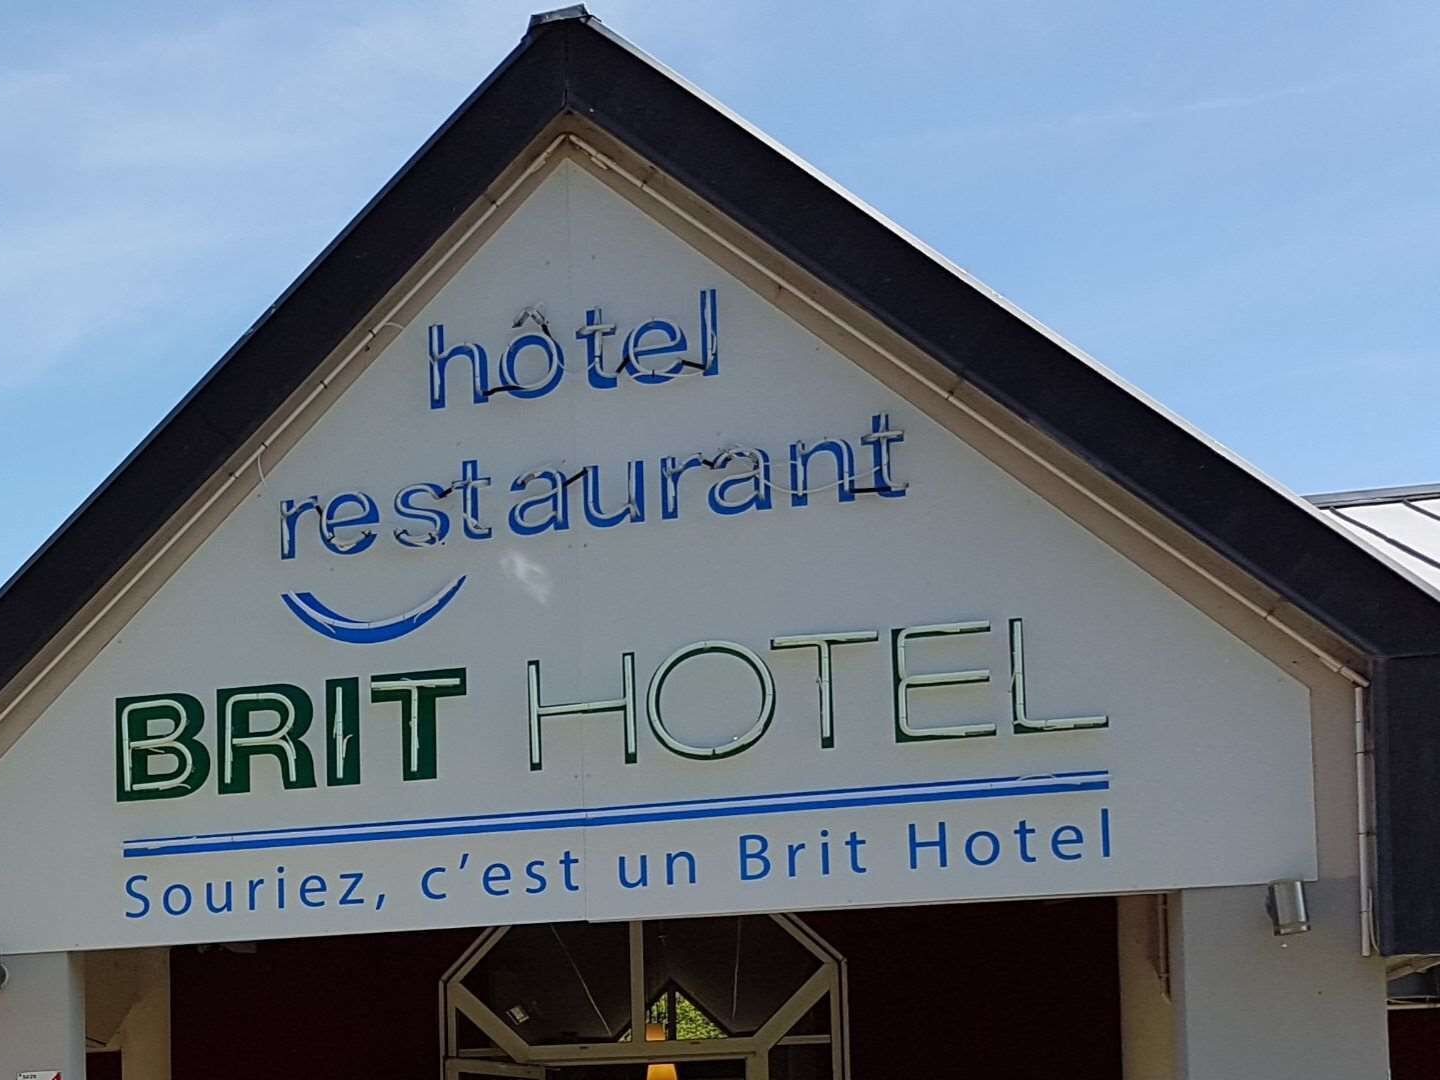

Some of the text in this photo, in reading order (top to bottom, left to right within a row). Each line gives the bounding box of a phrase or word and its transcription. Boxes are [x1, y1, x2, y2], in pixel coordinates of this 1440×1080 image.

[428, 289, 719, 410] hôtel
[279, 412, 908, 560] restaurant
[115, 618, 1109, 802] BRIT HOTEL
[123, 865, 387, 919] Souriez,
[617, 849, 697, 889] un
[738, 829, 867, 881] Brit
[907, 808, 1112, 870] Hotel
